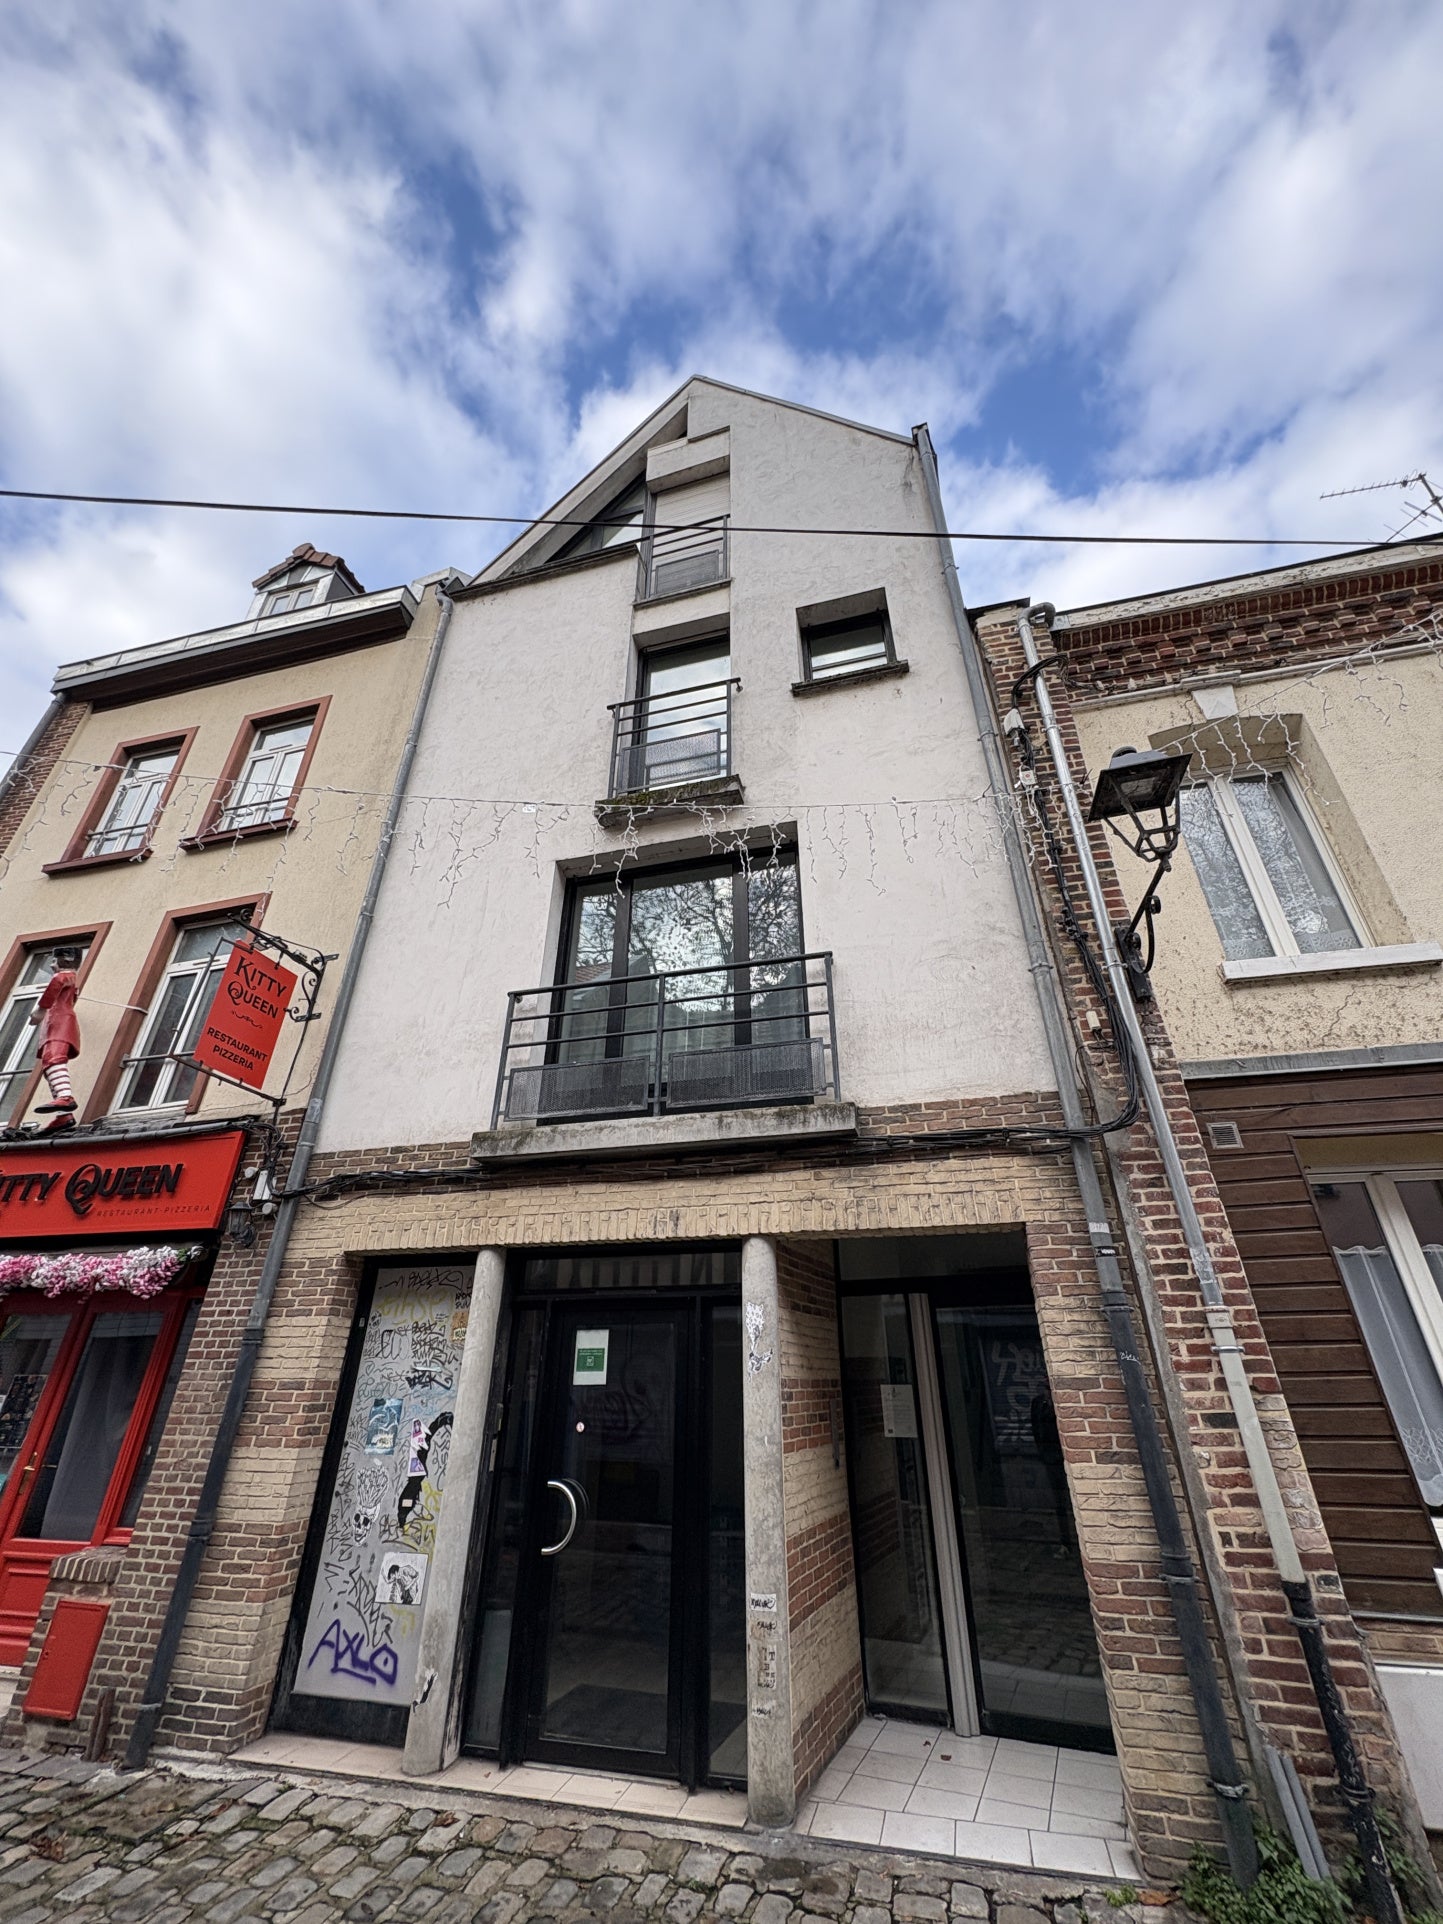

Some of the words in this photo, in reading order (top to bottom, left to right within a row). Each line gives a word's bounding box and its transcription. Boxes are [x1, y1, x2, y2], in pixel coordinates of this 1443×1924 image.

[234, 956, 287, 998] KITTY
[227, 980, 279, 1019] QUEEN
[207, 1027, 268, 1062] RESTAURANT
[213, 1045, 254, 1070] PIZZERIA
[0, 1169, 62, 1202] ITTY
[65, 1164, 184, 1215] QUEEN
